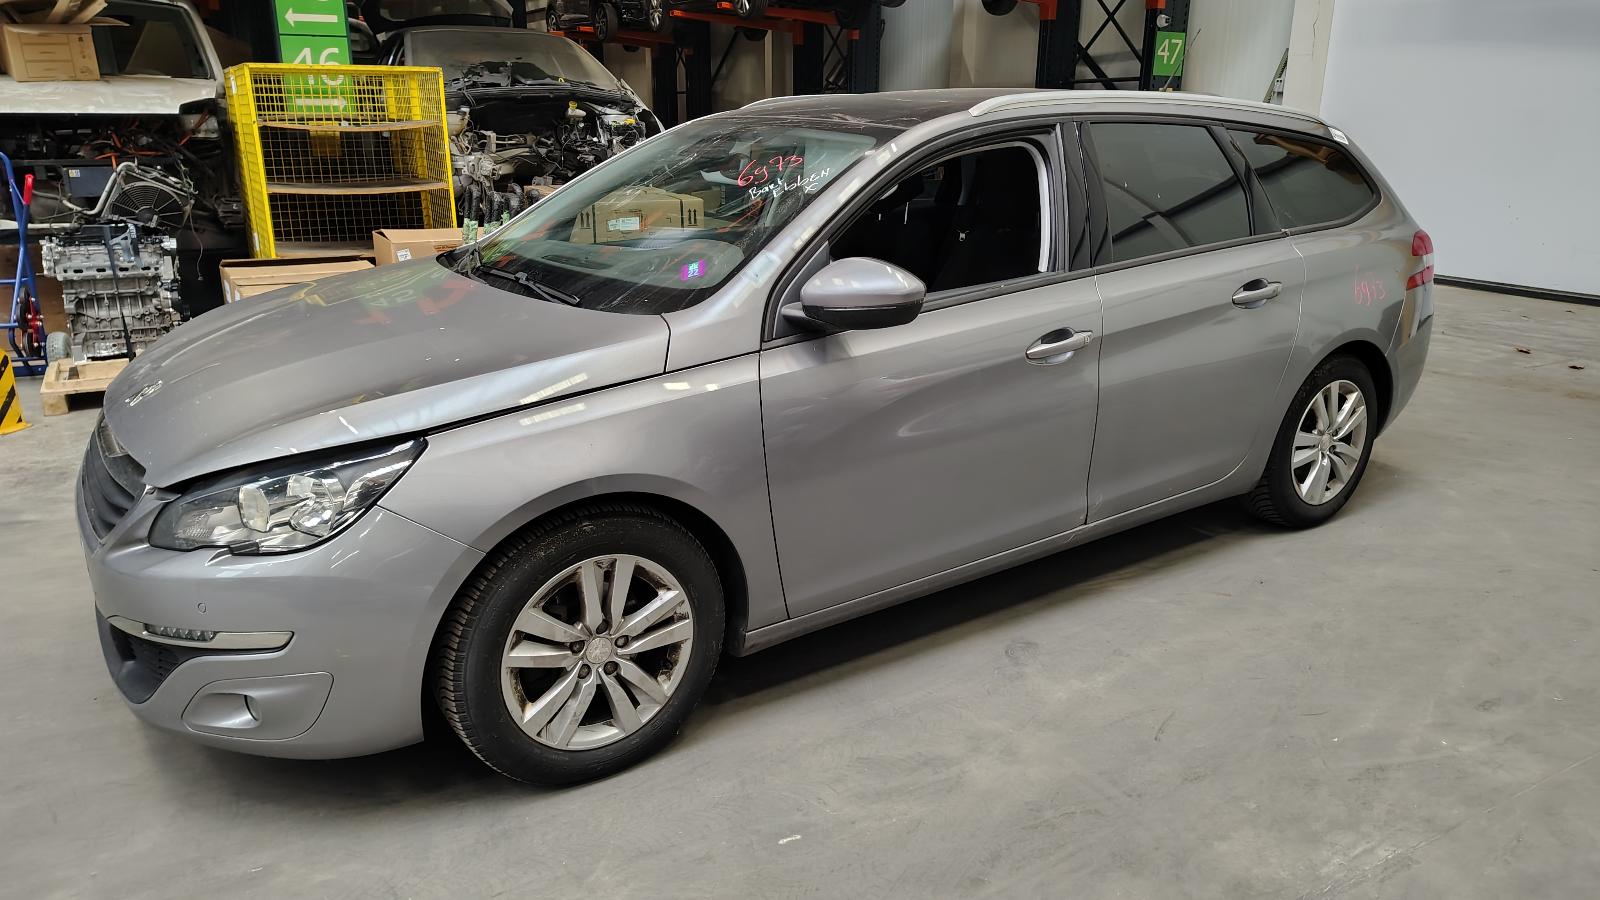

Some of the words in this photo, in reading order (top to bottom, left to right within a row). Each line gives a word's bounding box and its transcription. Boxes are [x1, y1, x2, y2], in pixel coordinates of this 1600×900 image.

[291, 47, 345, 86] 46
[1157, 38, 1183, 65] 47
[737, 155, 804, 187] 6973
